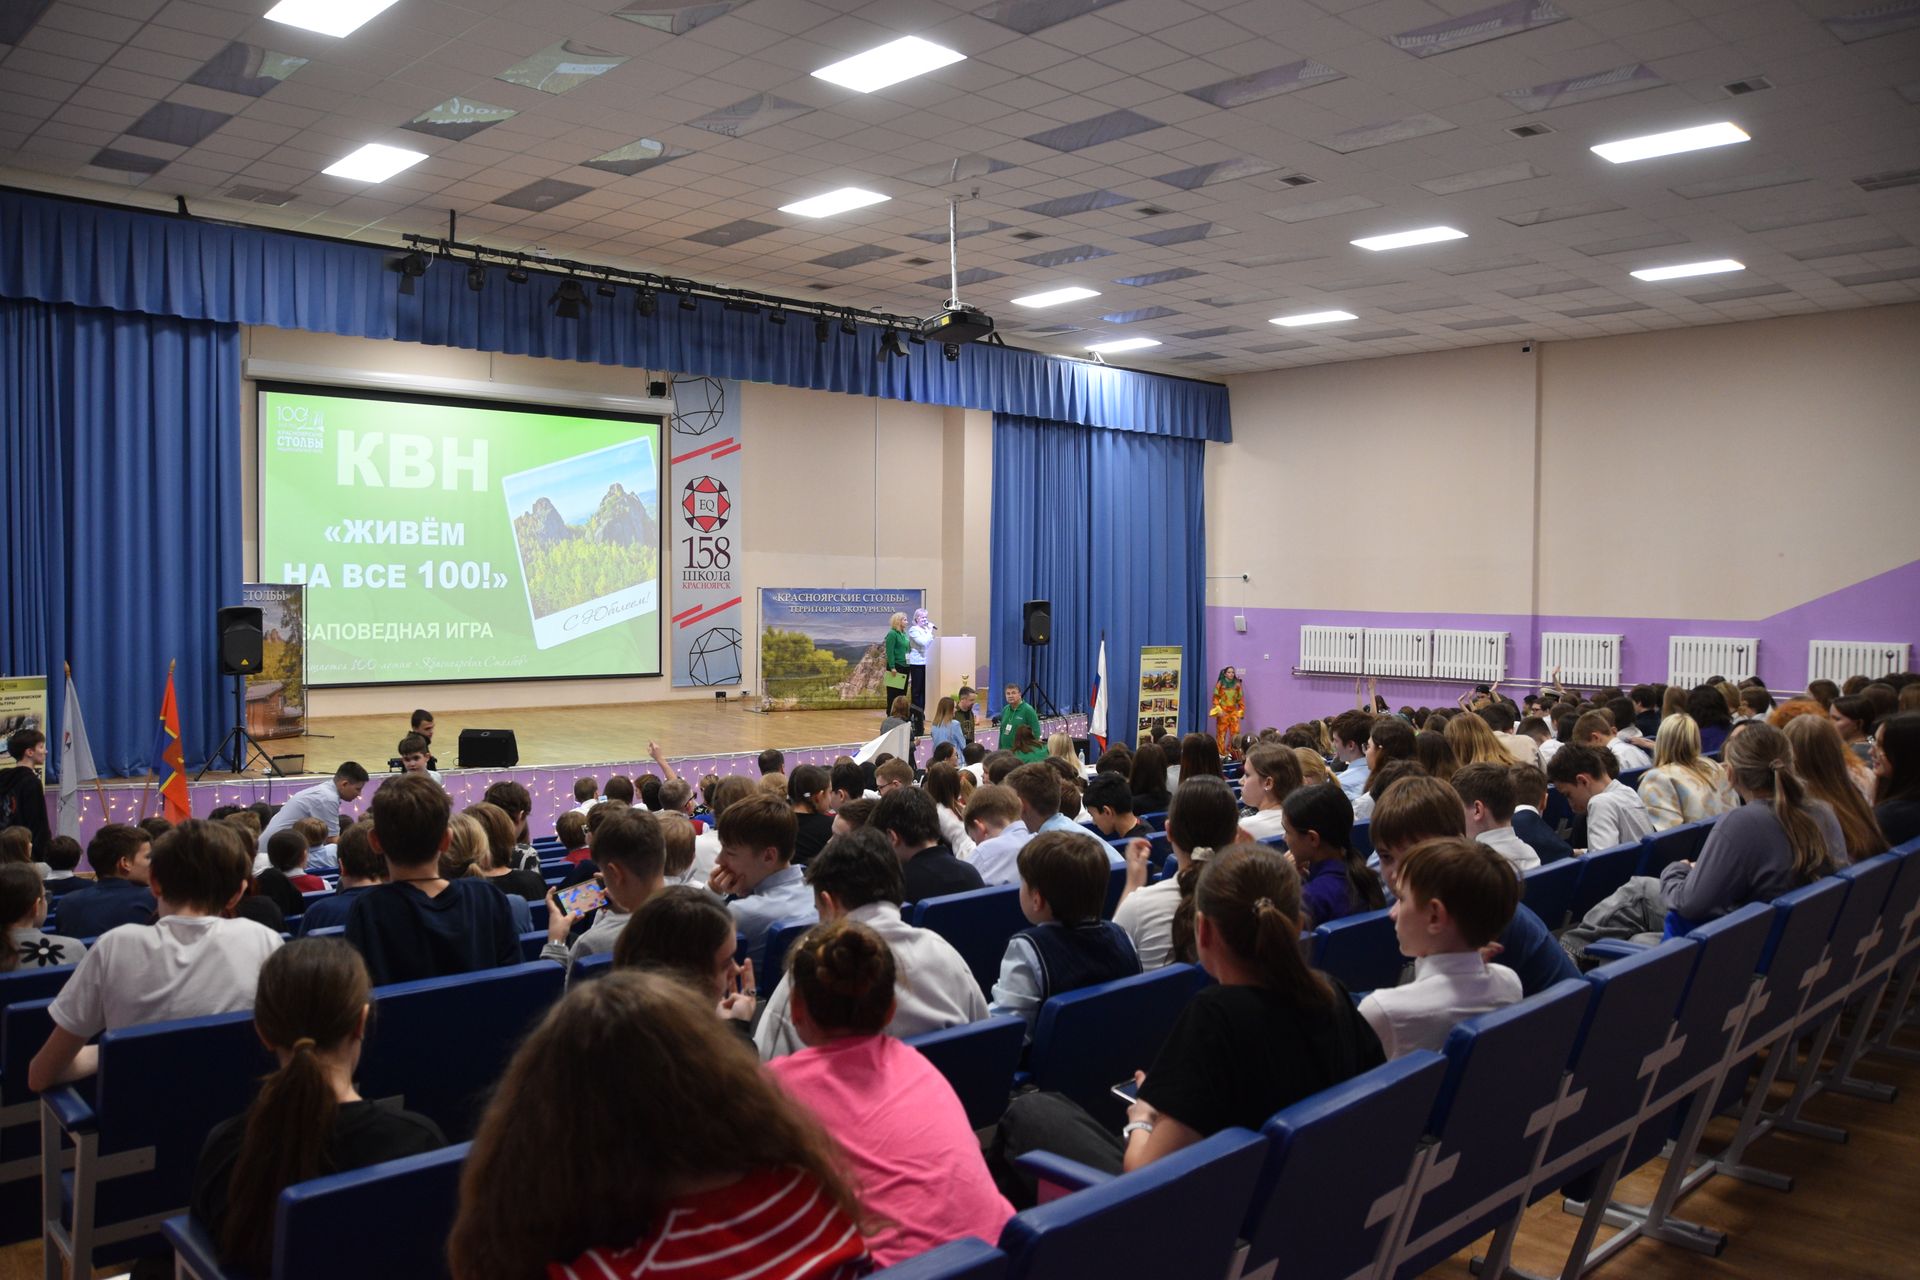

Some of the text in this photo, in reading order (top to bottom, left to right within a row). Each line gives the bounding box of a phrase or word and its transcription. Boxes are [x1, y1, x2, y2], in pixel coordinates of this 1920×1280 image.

[277, 436, 324, 449] СТОЛБЫ
[337, 429, 489, 492] КВН
[699, 500, 715, 512] EQ
[324, 516, 465, 546] «ЖИВЁМ
[682, 536, 731, 569] 158
[283, 560, 508, 589] НА ВСЕ 100!»
[682, 582, 731, 590] КРАСНОЯРСК
[773, 593, 909, 603] «КРАСНОЯРСКИЕ СТОЛБЫ»
[789, 605, 896, 613] ТЕРРИТОРИЯ ЭКОТУРИЗМА
[446, 622, 494, 639] ИГРА
